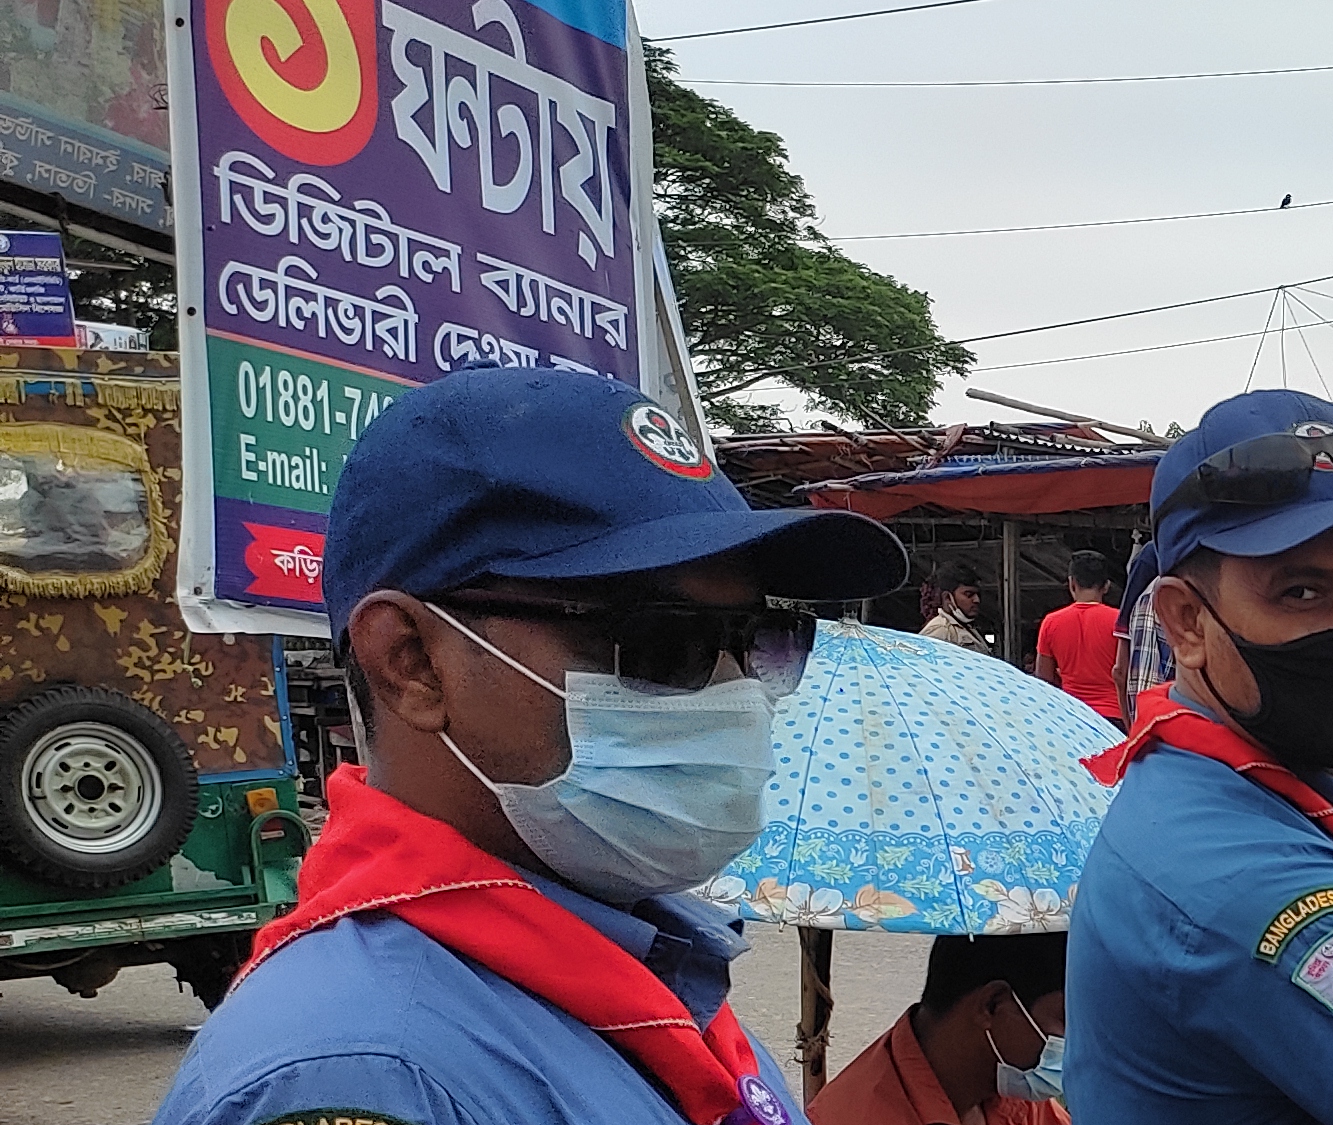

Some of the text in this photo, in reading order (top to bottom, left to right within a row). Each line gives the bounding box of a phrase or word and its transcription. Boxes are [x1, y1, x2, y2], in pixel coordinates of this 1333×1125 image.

[213, 151, 628, 351] ডিজিটাল ব্যানার
[218, 255, 419, 364] ডেলিভারী
[238, 361, 394, 441] 01881-74
[240, 433, 329, 495] E-mail:
[270, 544, 323, 584] কড়ি
